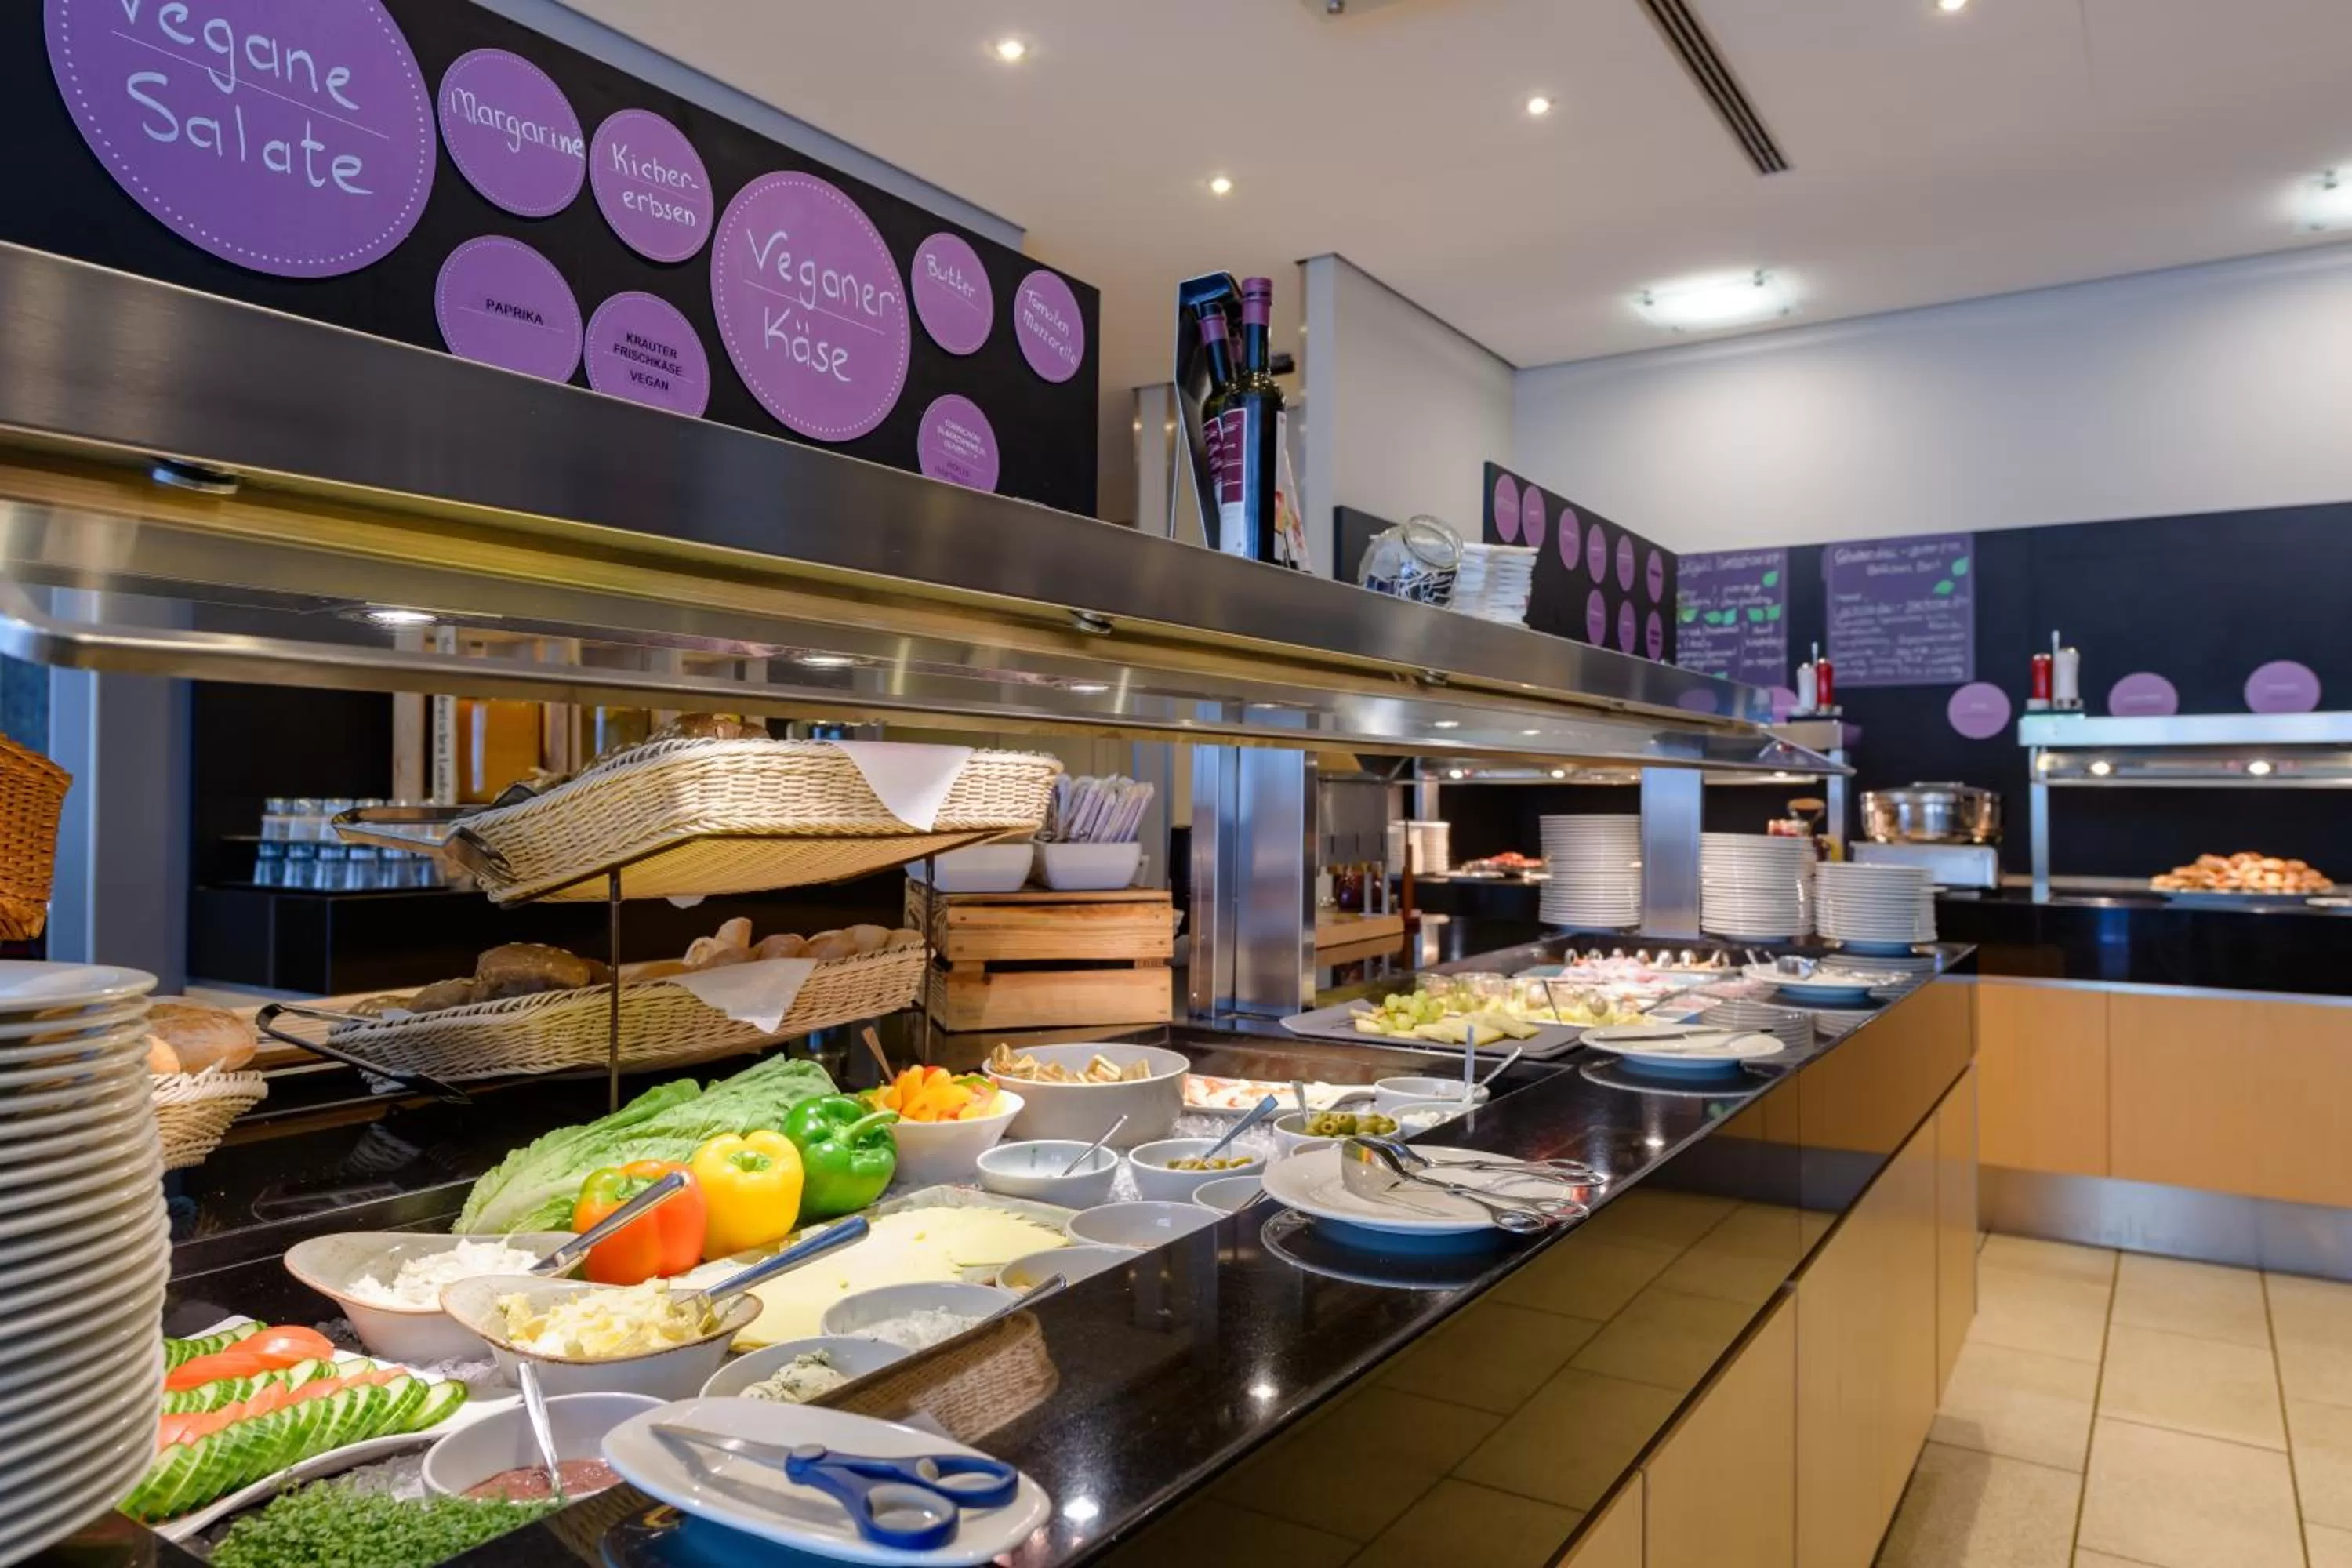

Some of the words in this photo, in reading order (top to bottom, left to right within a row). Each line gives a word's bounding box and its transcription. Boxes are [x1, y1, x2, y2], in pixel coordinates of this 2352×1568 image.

[127, 71, 374, 195] Salate
[451, 87, 586, 158] Margarine
[612, 143, 700, 190] Kicher-
[622, 191, 696, 227] erbsen
[746, 228, 895, 317] Veganer
[925, 253, 976, 299] Butter
[485, 299, 543, 325] PAPRIKA
[764, 307, 851, 382] Käse
[630, 369, 669, 391] VEGAN
